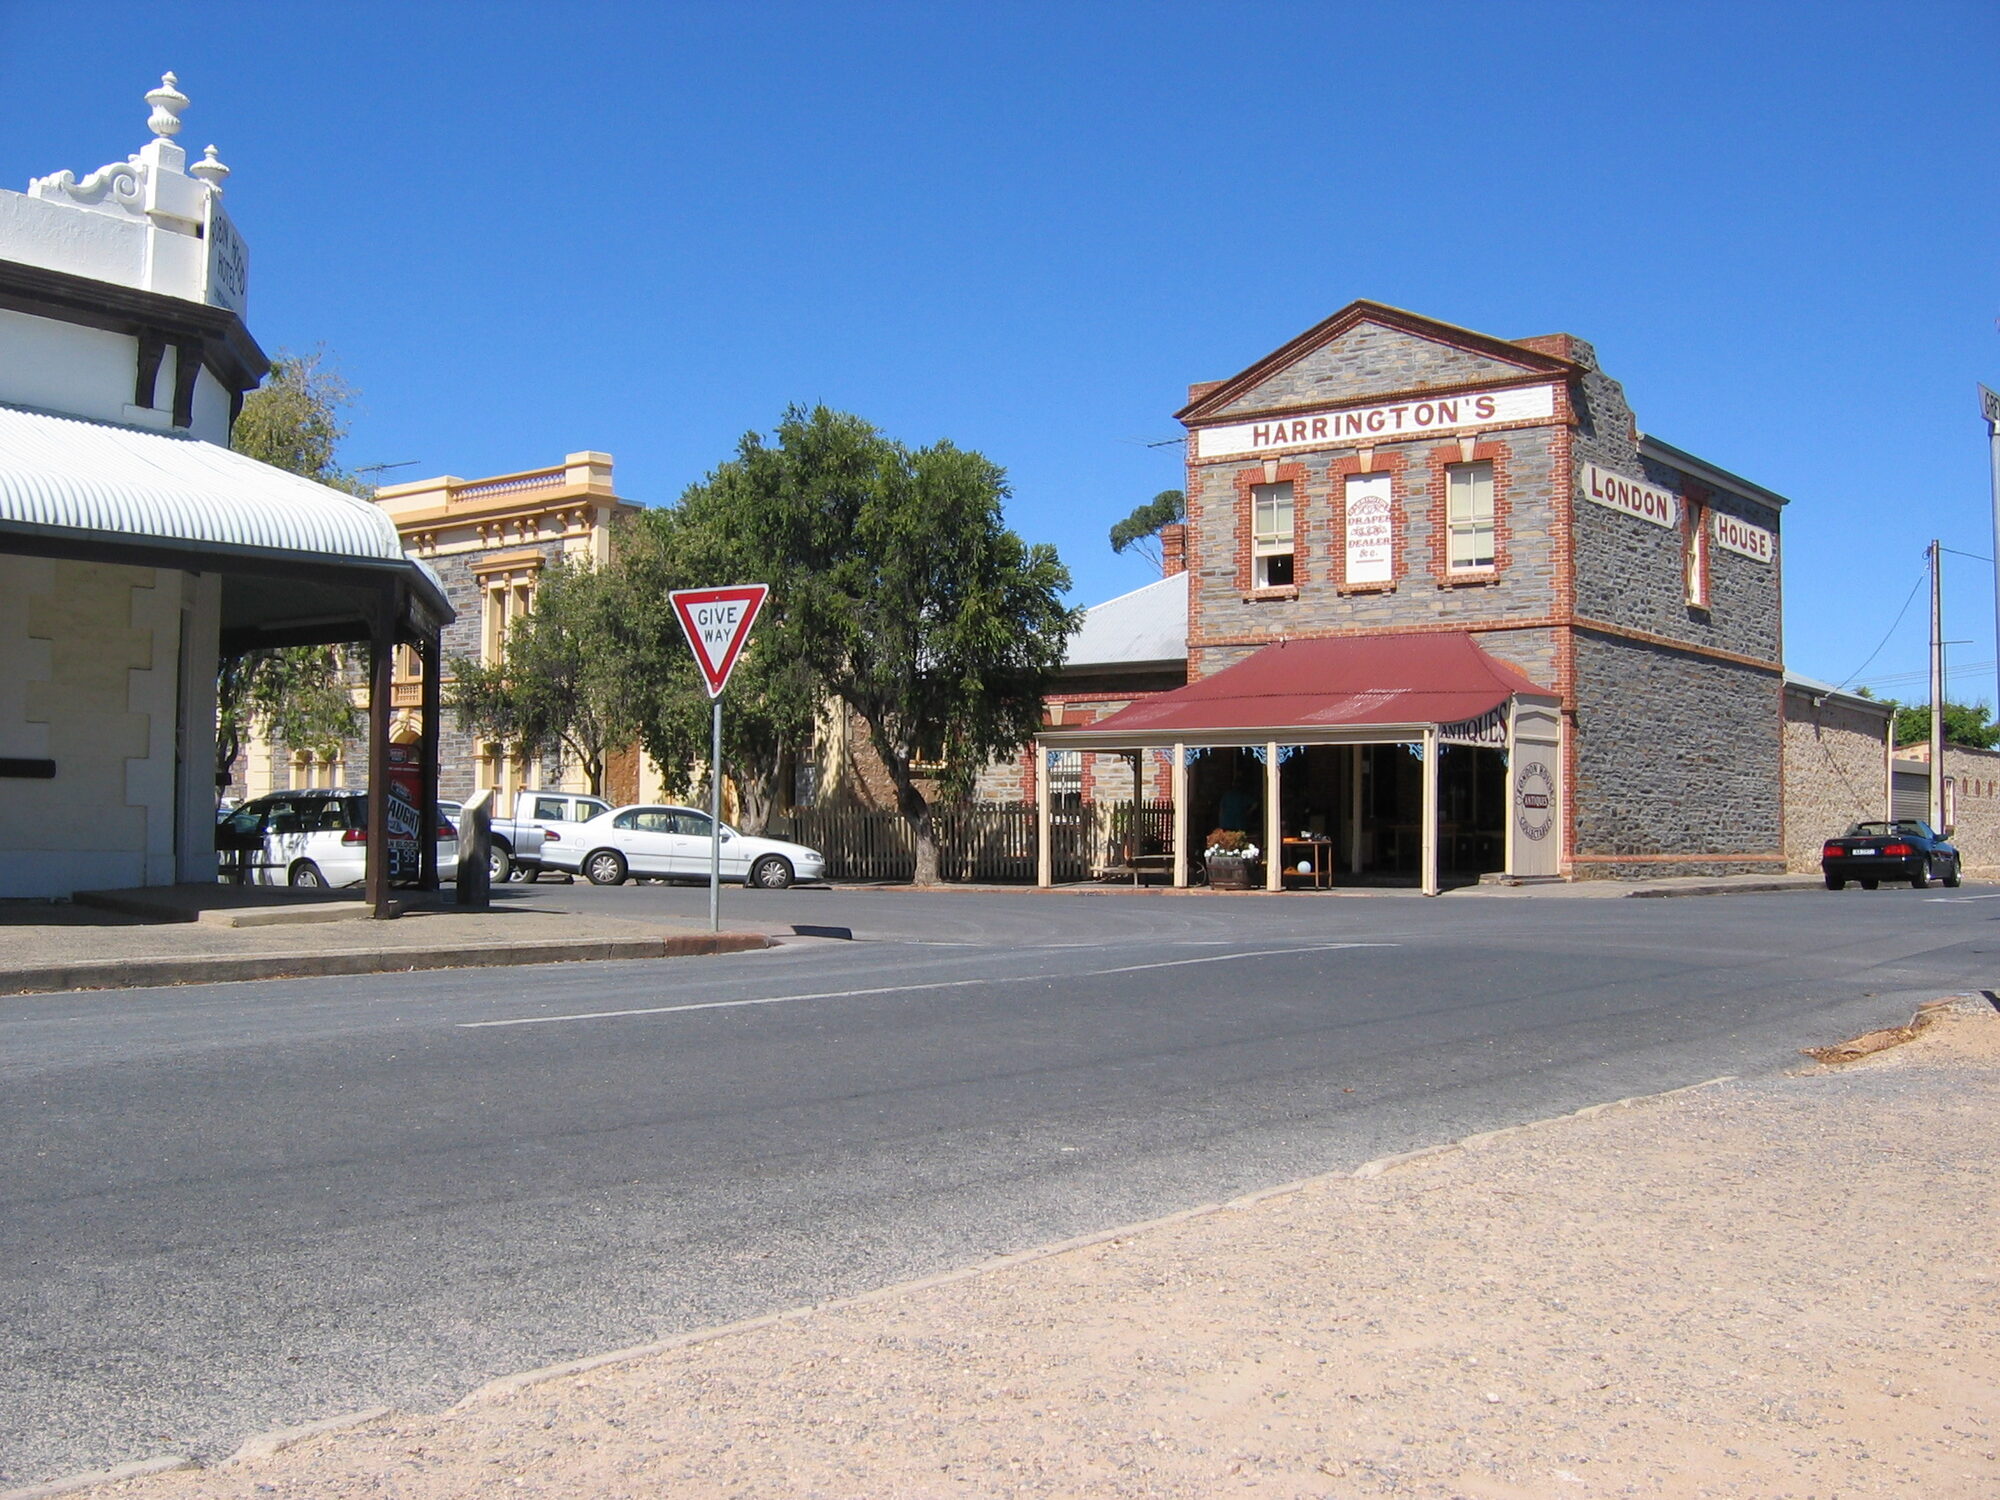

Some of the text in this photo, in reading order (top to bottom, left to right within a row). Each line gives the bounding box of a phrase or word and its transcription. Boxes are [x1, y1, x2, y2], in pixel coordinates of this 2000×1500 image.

[1252, 395, 1496, 447] HARRINGTON'S
[1591, 467, 1767, 557] LONDON HOUSE
[1348, 536, 1391, 549] DEALER
[698, 606, 737, 626] GIVE
[704, 628, 732, 643] WAY
[1440, 702, 1508, 743] ANTIQUES
[1517, 763, 1538, 796] LONDON
[388, 799, 420, 835] AUGHT
[1524, 795, 1548, 807] ANTIQUES
